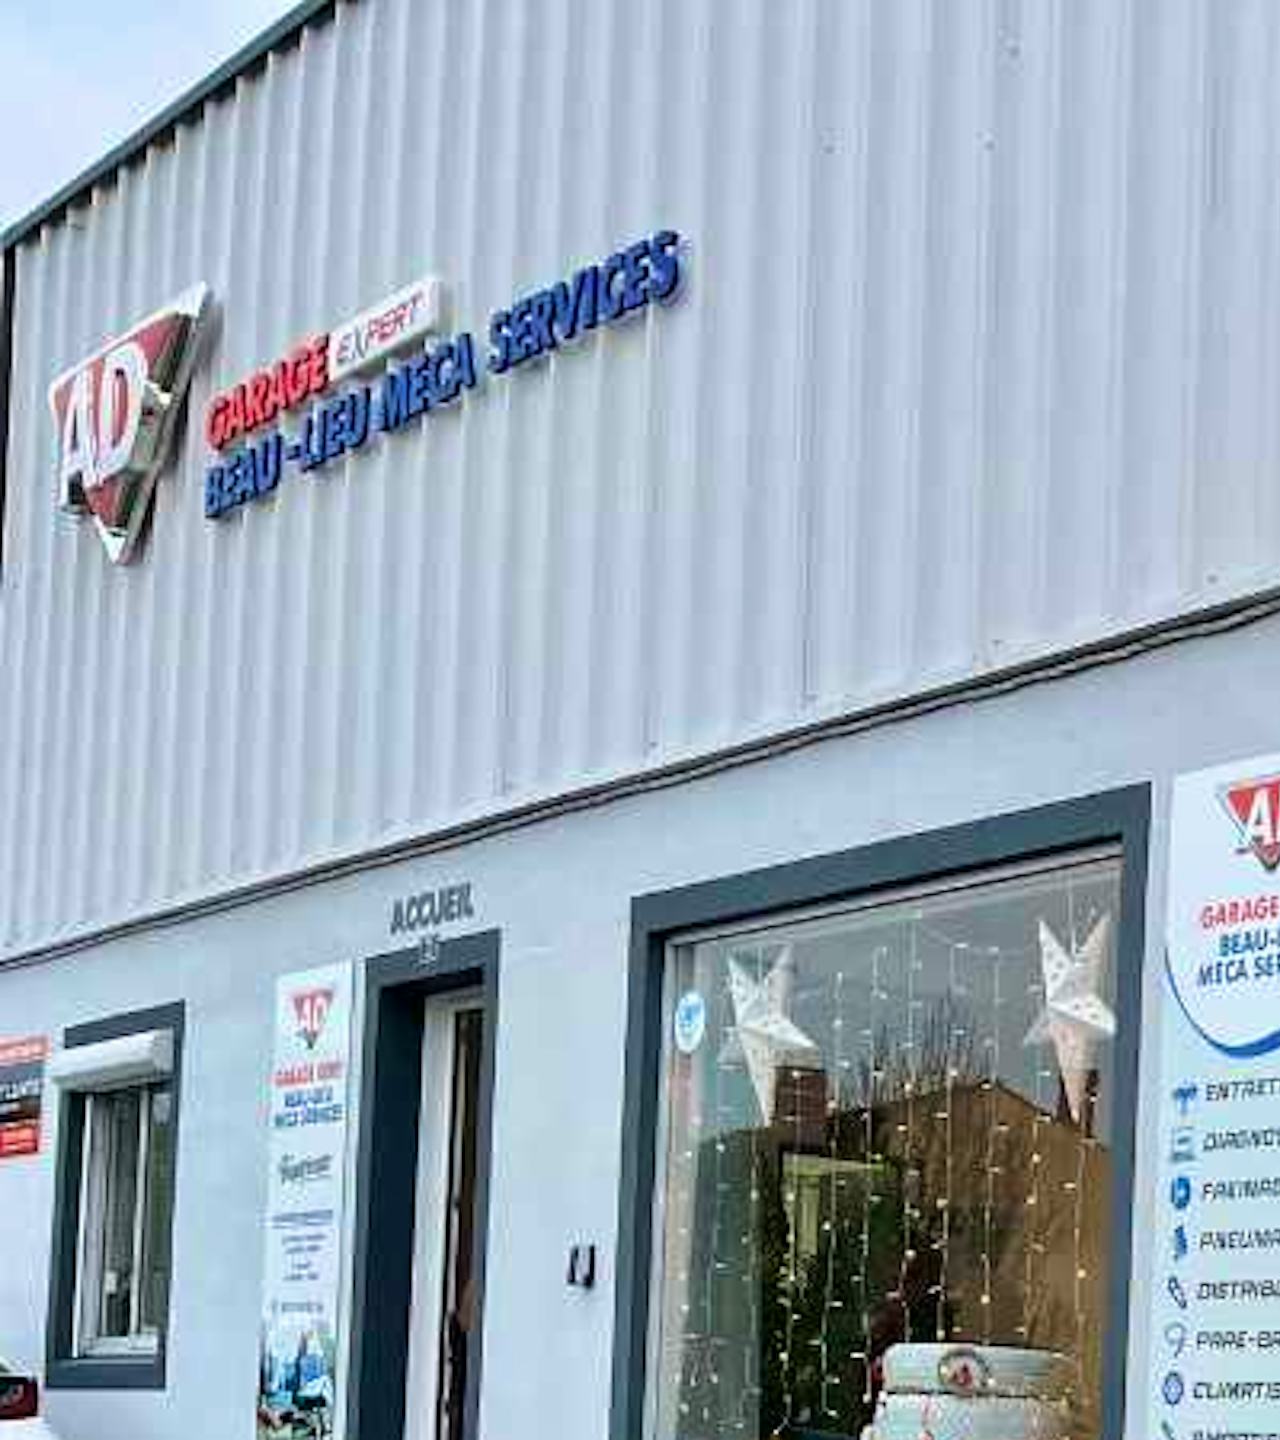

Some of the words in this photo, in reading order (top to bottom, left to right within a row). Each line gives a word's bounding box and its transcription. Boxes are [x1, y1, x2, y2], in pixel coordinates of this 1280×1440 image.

[205, 332, 333, 450] GARAGE
[335, 290, 426, 364] EXPERT
[488, 231, 678, 373] SERVICES
[60, 341, 148, 507] AD
[391, 882, 474, 935] ACCUEIL
[1201, 896, 1279, 929] GARAGE
